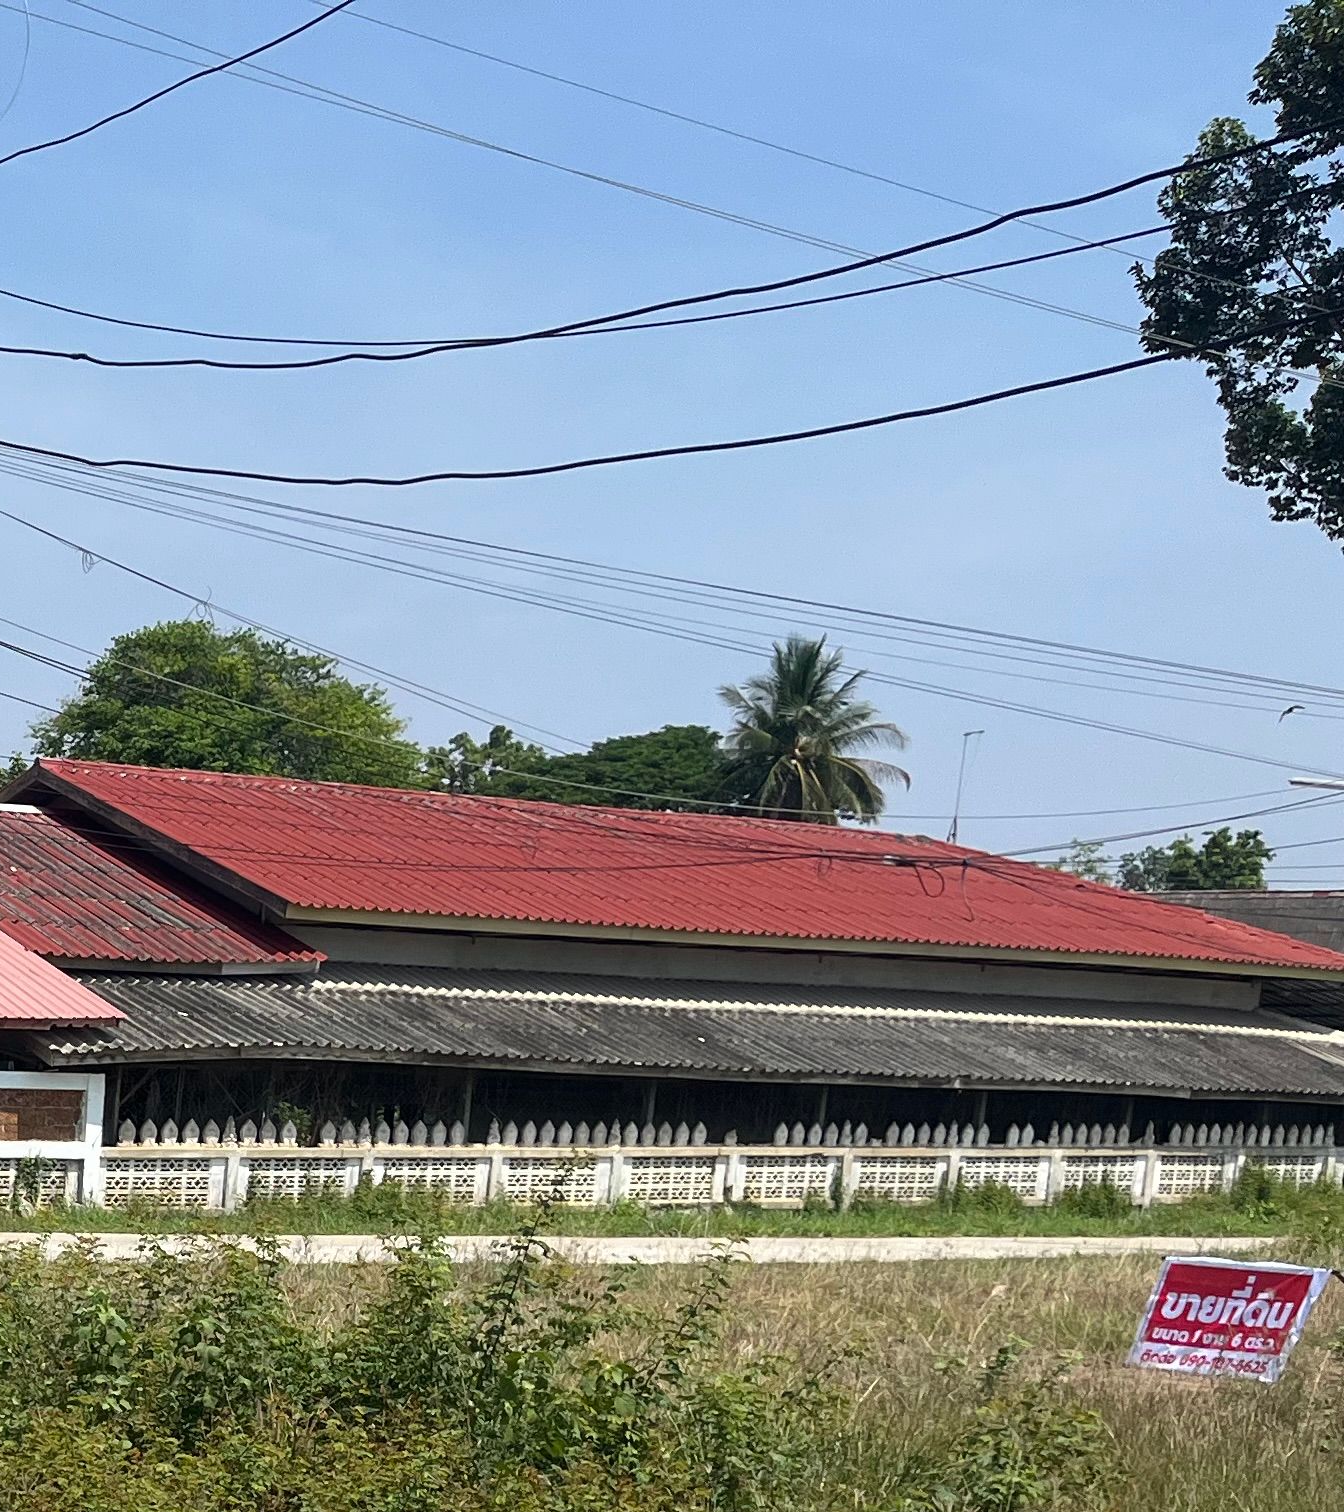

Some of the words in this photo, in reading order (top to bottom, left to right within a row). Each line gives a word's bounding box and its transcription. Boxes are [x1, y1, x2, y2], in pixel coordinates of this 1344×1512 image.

[1160, 1275, 1295, 1330] ขายที่ดิน
[1152, 1327, 1189, 1343] ขนาด
[1192, 1329, 1203, 1343] 1
[1231, 1333, 1243, 1348] 6
